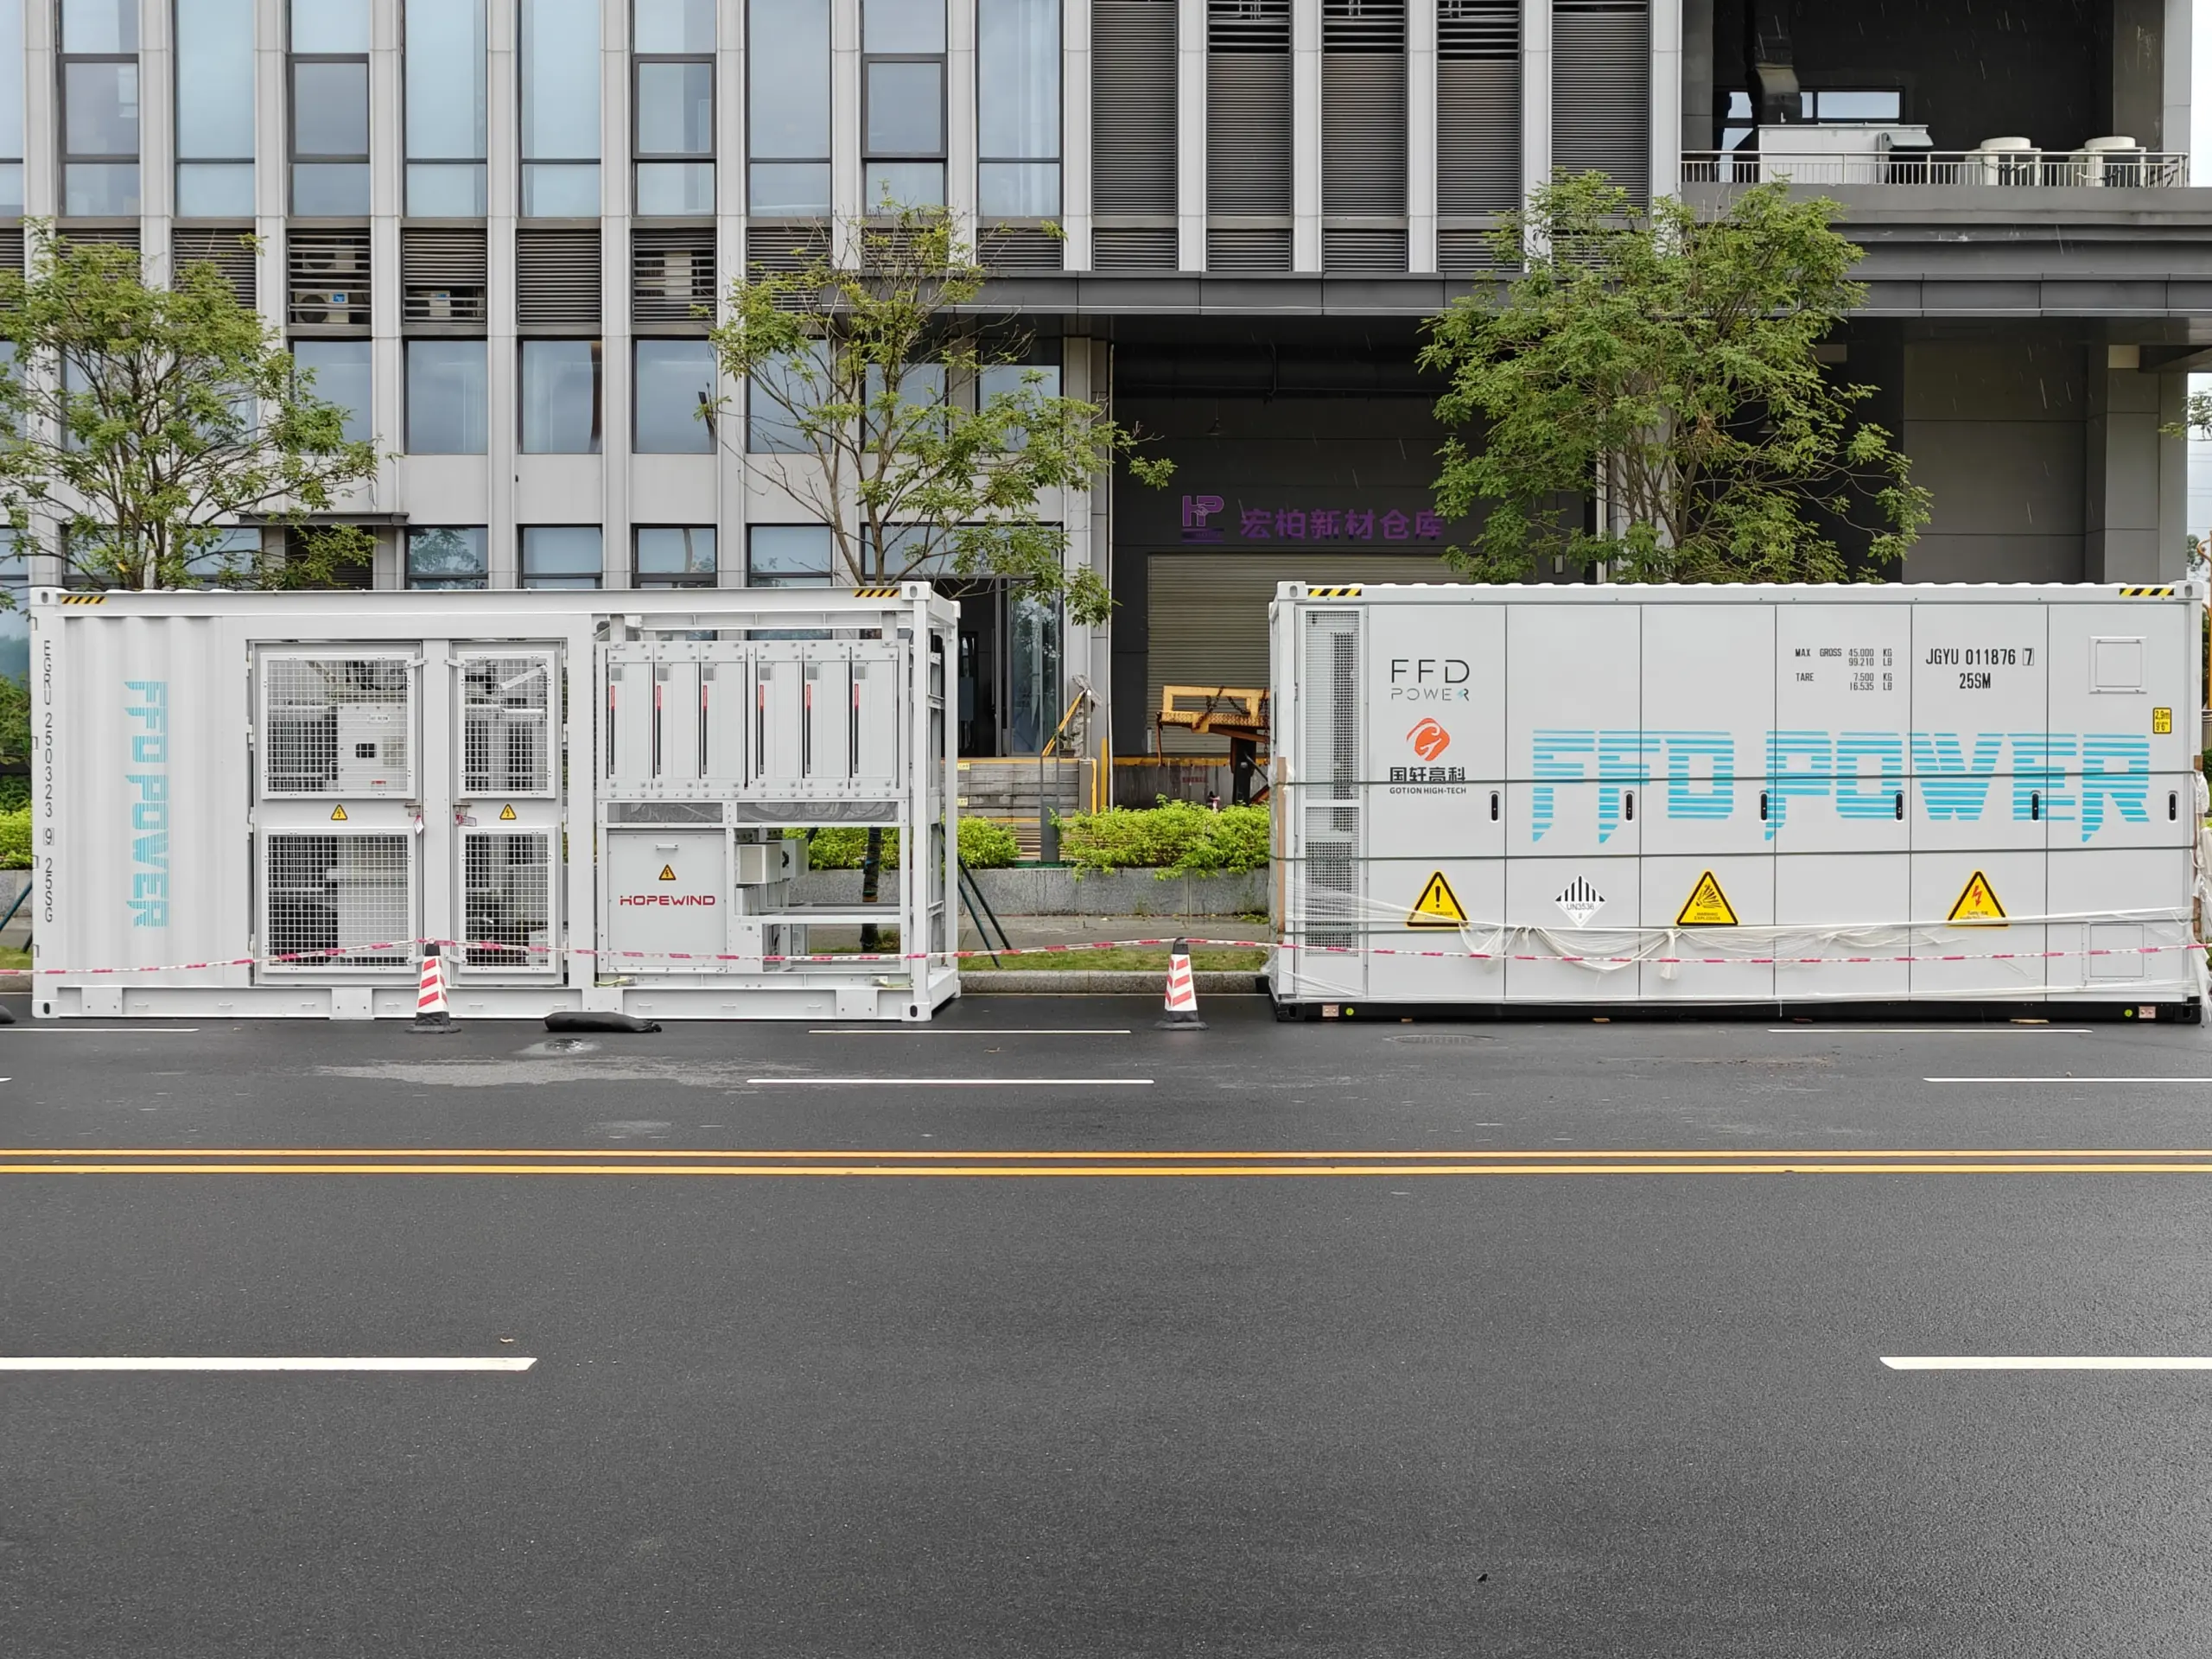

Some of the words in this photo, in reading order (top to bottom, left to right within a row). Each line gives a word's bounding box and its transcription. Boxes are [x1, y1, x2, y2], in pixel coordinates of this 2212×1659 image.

[1240, 508, 1444, 540] 宏柏新材仓库
[1795, 648, 1811, 657] MAX
[1820, 648, 1842, 657] GROSS
[1883, 648, 1892, 657] KG
[1925, 649, 1959, 664] JGYU
[1966, 649, 2016, 665] 011876
[2024, 648, 2033, 665] 7
[1883, 658, 1892, 666] LB
[1391, 659, 1470, 683] FFD
[1796, 672, 1815, 682] TARE
[1883, 672, 1892, 681] KG
[1883, 682, 1892, 690] LB
[1959, 672, 1991, 690] 25SM
[1391, 688, 1470, 701] POWER
[1389, 766, 1466, 784] 国轩高科
[1764, 731, 2150, 843] POWER
[45, 828, 53, 845] 9
[124, 774, 168, 927] POWER
[620, 895, 715, 906] HOPEWIND
